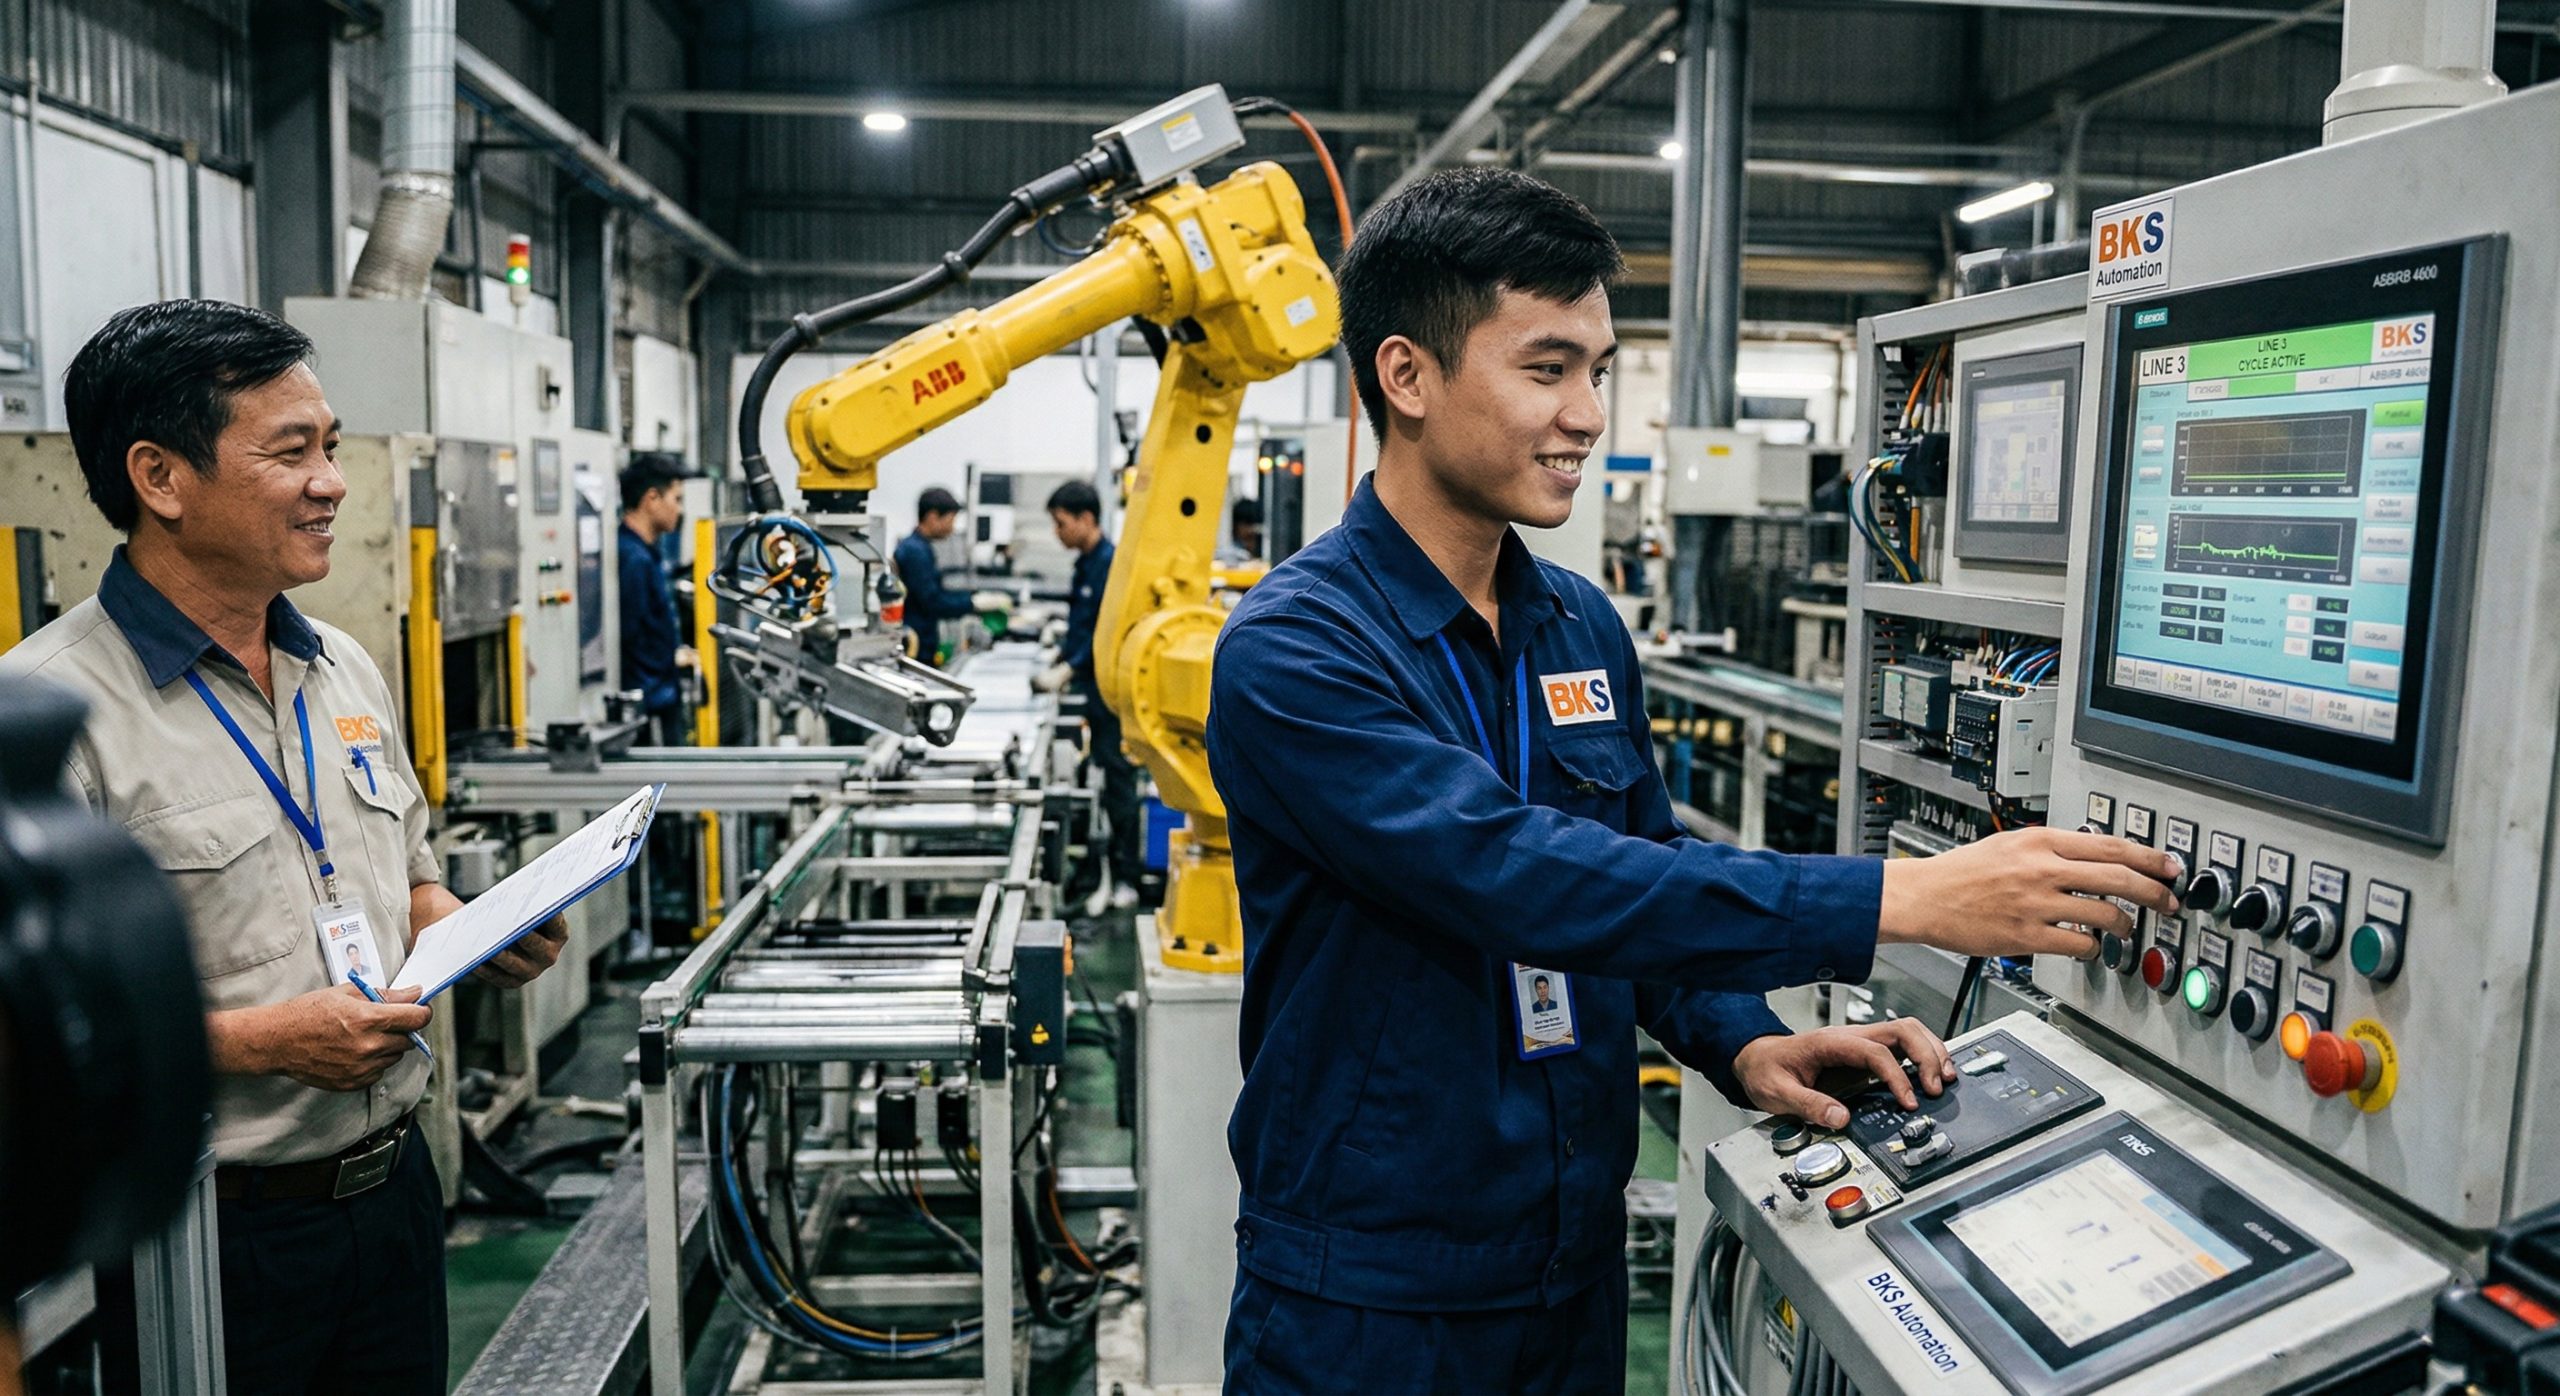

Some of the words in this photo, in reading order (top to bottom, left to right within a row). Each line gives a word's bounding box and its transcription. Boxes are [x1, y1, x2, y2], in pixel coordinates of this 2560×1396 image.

[2098, 211, 2164, 264] BKS
[2095, 260, 2163, 287] Automation
[2258, 341, 2279, 352] LINE
[2281, 338, 2288, 349] 3
[2381, 322, 2427, 348] BKS
[2142, 356, 2174, 377] LINE
[2177, 355, 2186, 374] 3
[2238, 357, 2269, 372] CYCLE
[2270, 353, 2306, 368] ACTIVE
[912, 359, 966, 406] ABB
[1547, 678, 1611, 718] BKS
[335, 715, 379, 742] BKS
[1867, 1272, 1905, 1303] BKS
[1889, 1302, 1958, 1373] Automation
